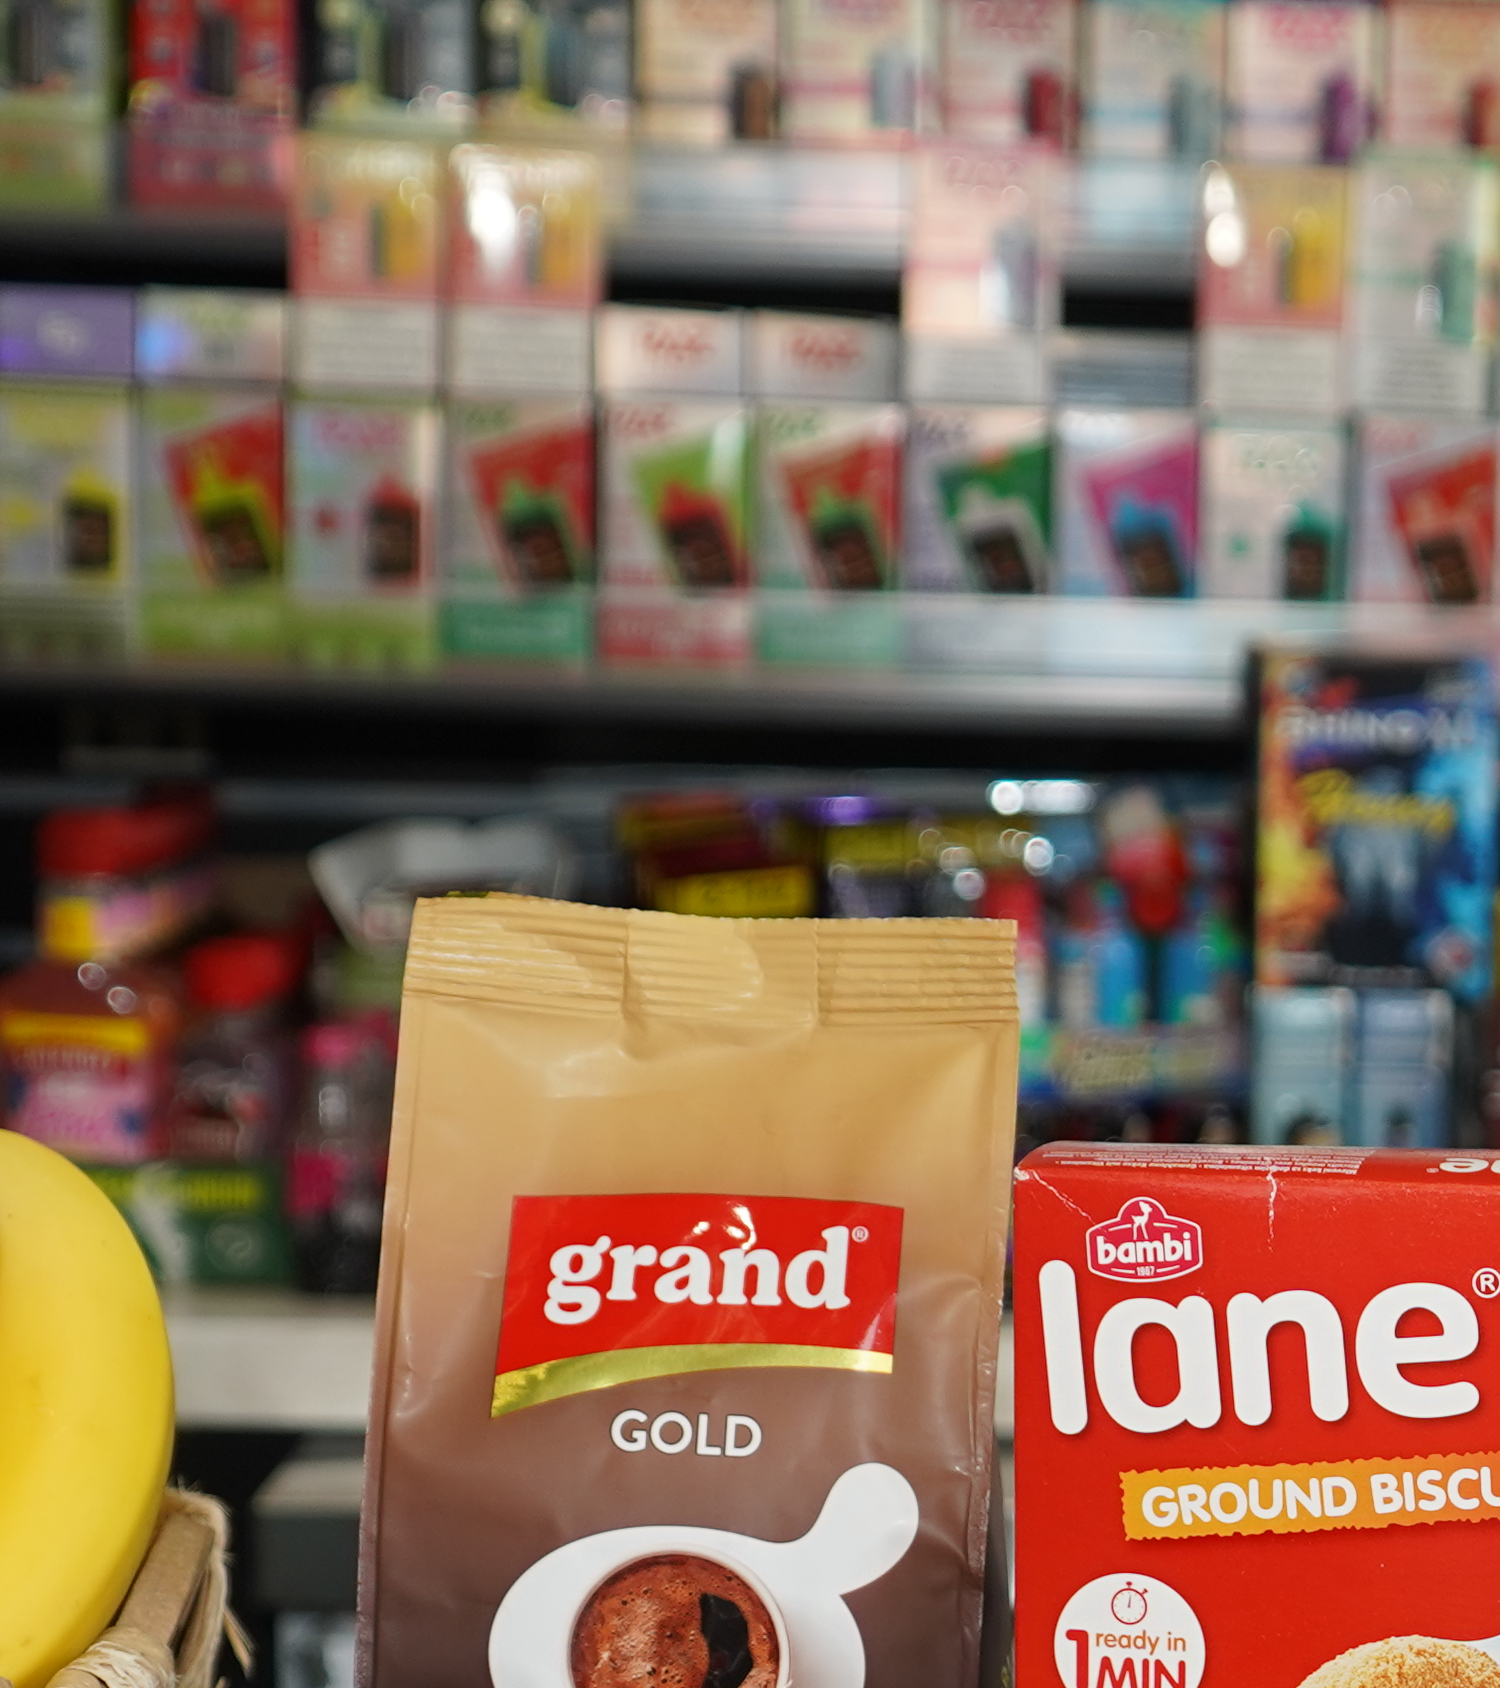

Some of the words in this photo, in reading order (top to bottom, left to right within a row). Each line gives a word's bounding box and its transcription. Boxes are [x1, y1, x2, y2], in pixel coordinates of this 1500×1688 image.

[1096, 1232, 1192, 1265] bambi
[544, 1225, 850, 1324] grand
[1038, 1259, 1480, 1434] lane
[610, 1409, 762, 1457] GOLD
[1141, 1474, 1356, 1527] GROUND
[1096, 1630, 1159, 1655] ready
[1167, 1632, 1186, 1652] in
